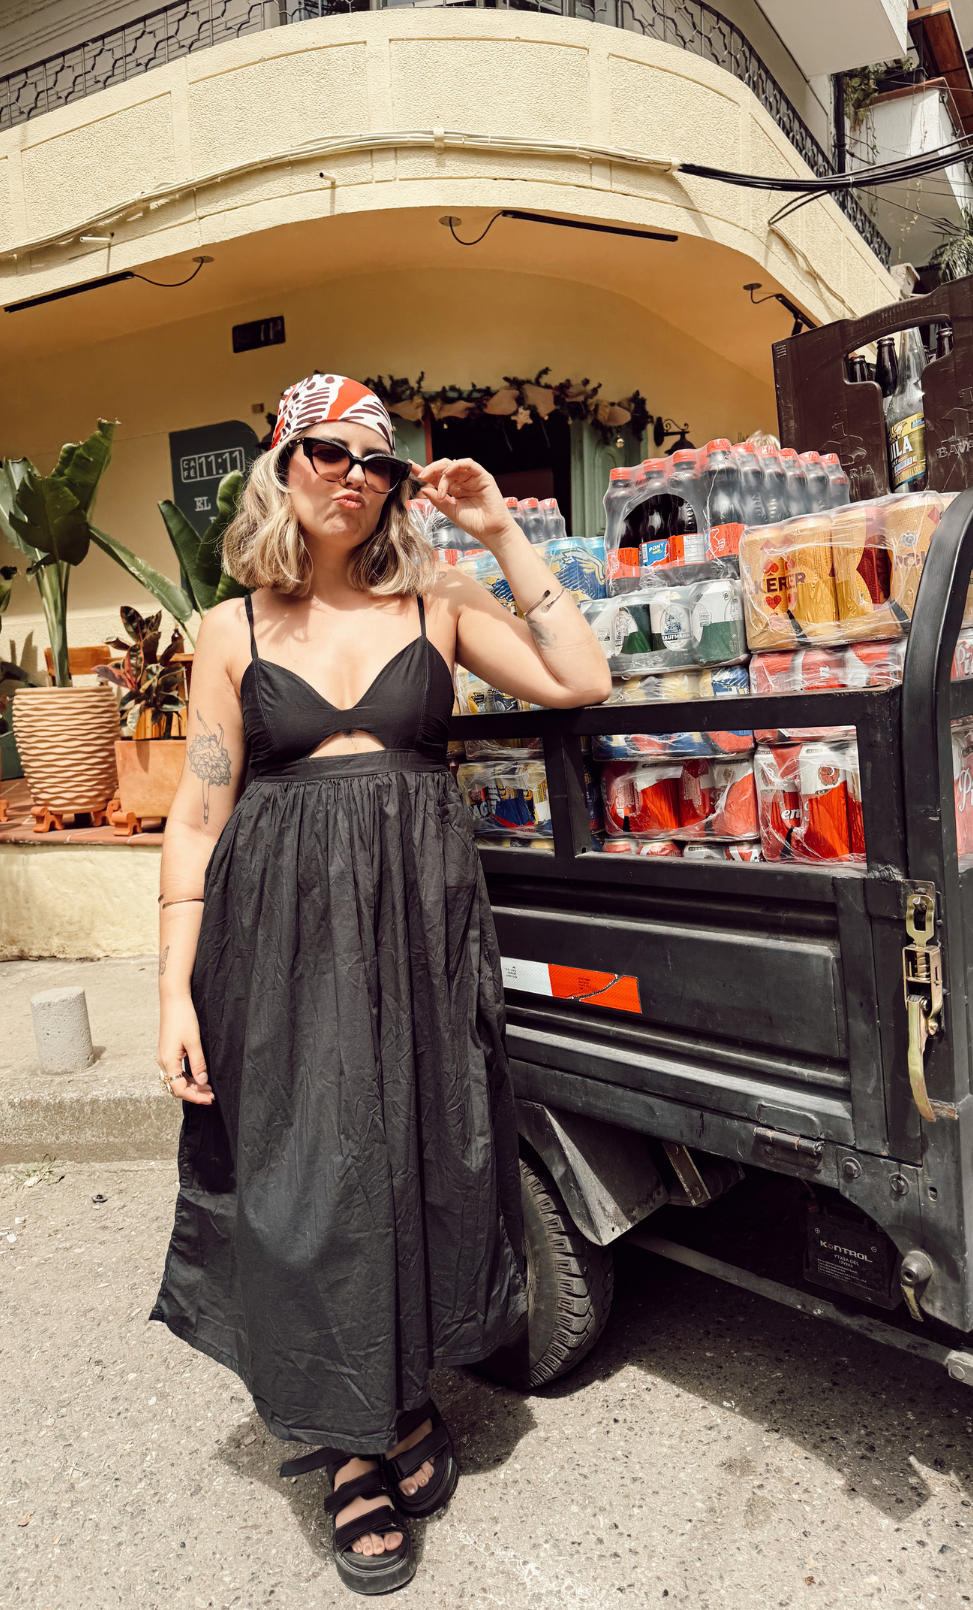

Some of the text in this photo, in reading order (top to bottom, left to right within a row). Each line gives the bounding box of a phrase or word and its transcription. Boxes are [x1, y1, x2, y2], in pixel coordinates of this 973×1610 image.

[199, 450, 241, 477] 11:11
[846, 464, 875, 479] RIA
[194, 496, 211, 511] EL
